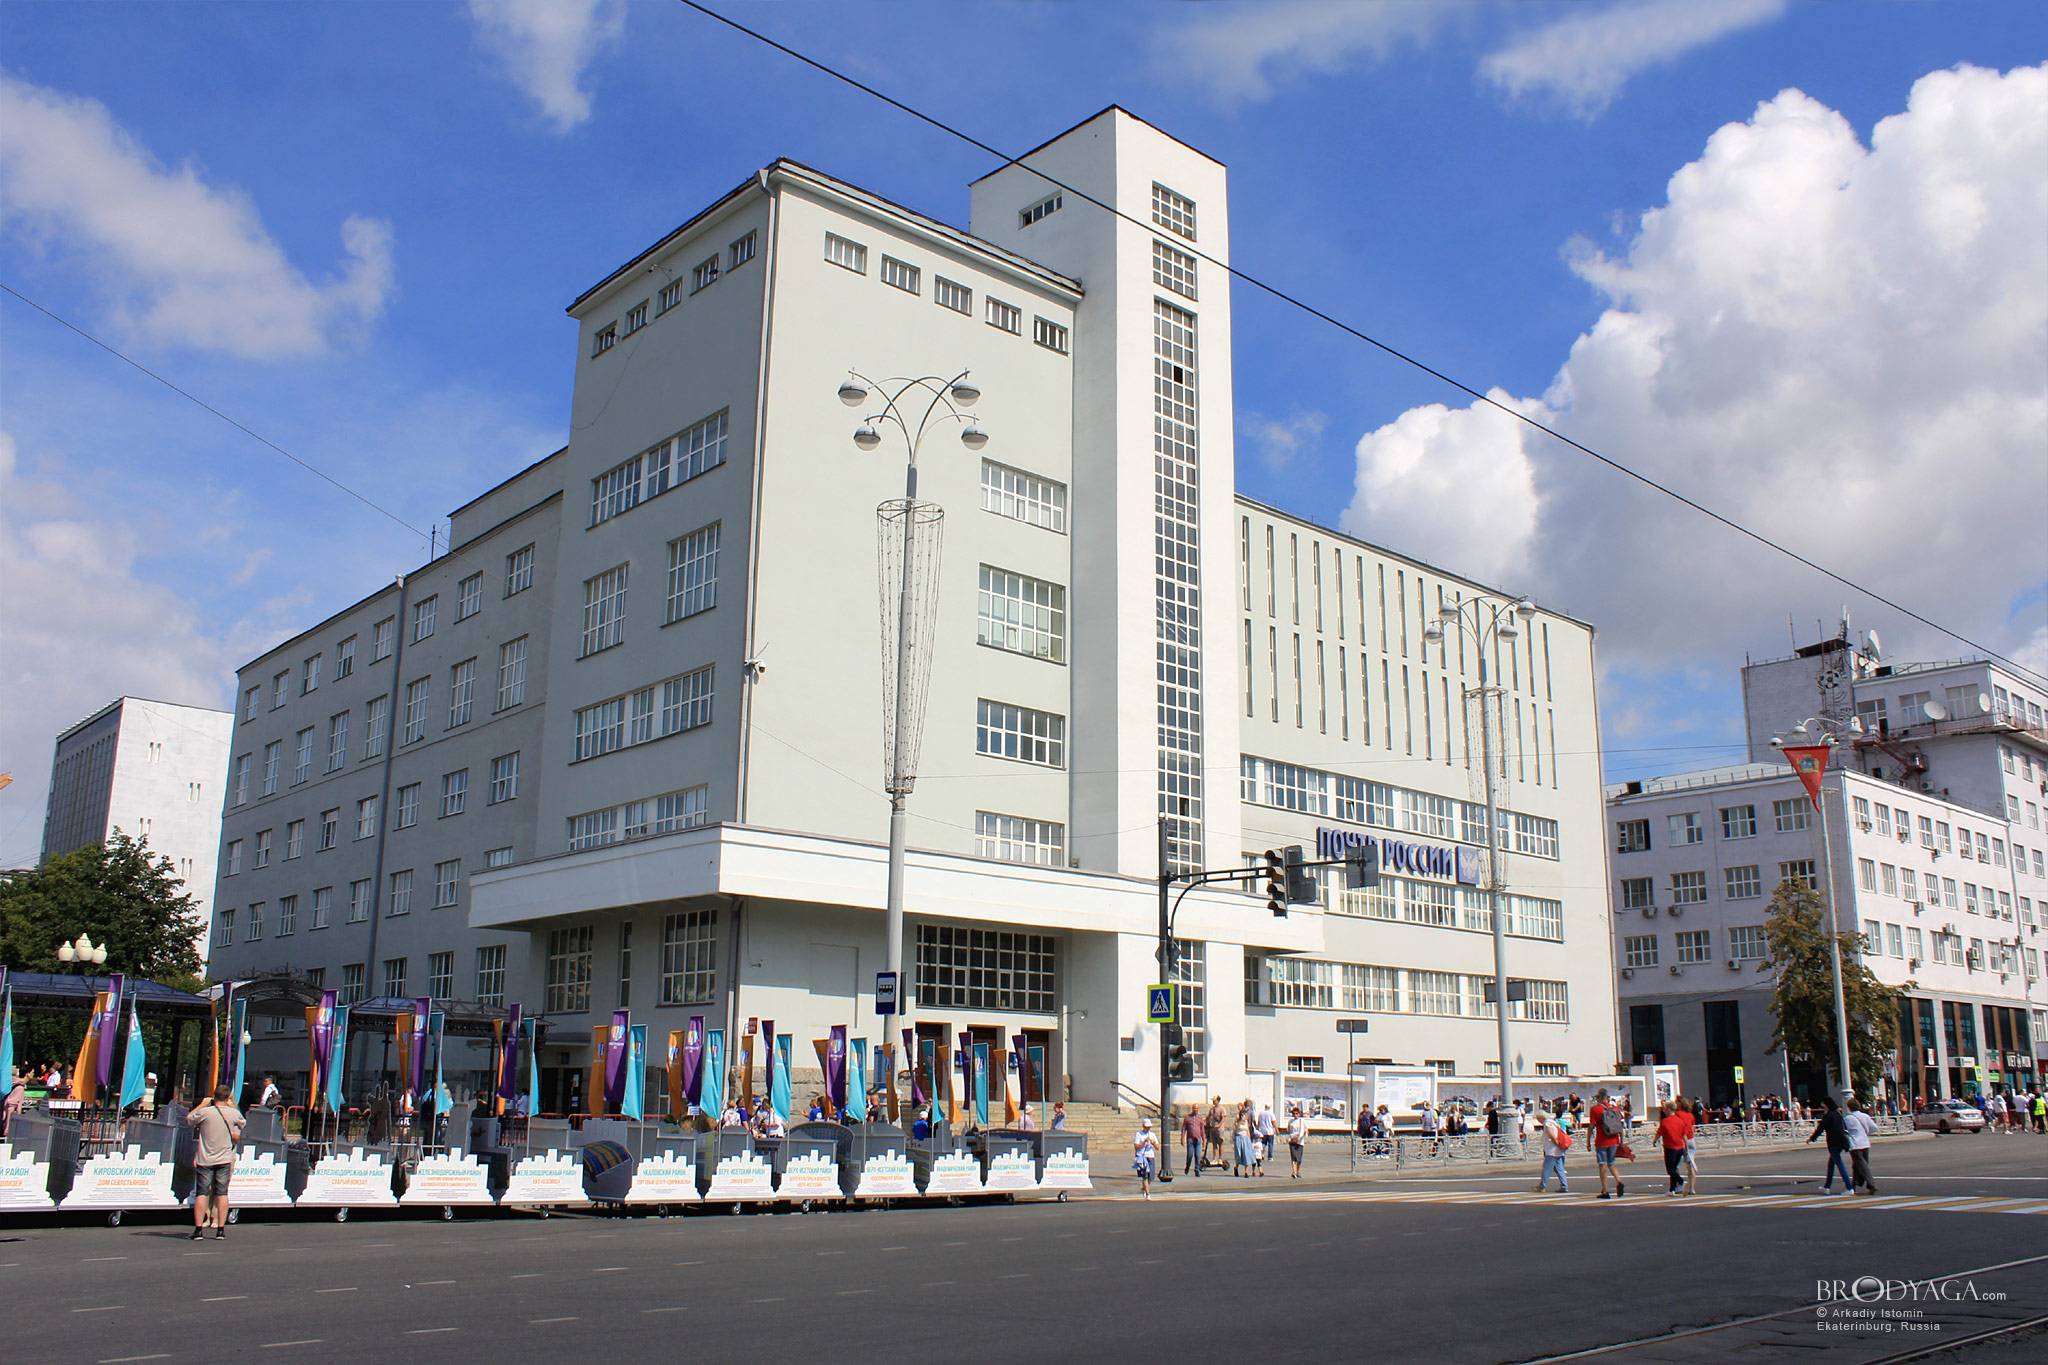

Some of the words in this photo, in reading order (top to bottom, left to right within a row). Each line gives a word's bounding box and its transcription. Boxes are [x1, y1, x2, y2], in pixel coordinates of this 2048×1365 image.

[1383, 838, 1453, 877] РОССИИ
[5, 1166, 30, 1177] РАЙОН
[93, 1166, 133, 1176] КИРОВСКИЙ
[134, 1166, 157, 1176] РАЙОН
[250, 1166, 271, 1176] РАЙОН
[316, 1168, 368, 1177] ЖЕЛЕЗНОДОРОЖНЫЙ
[368, 1168, 386, 1177] РАЙОН
[97, 1179, 110, 1187] ДОМ
